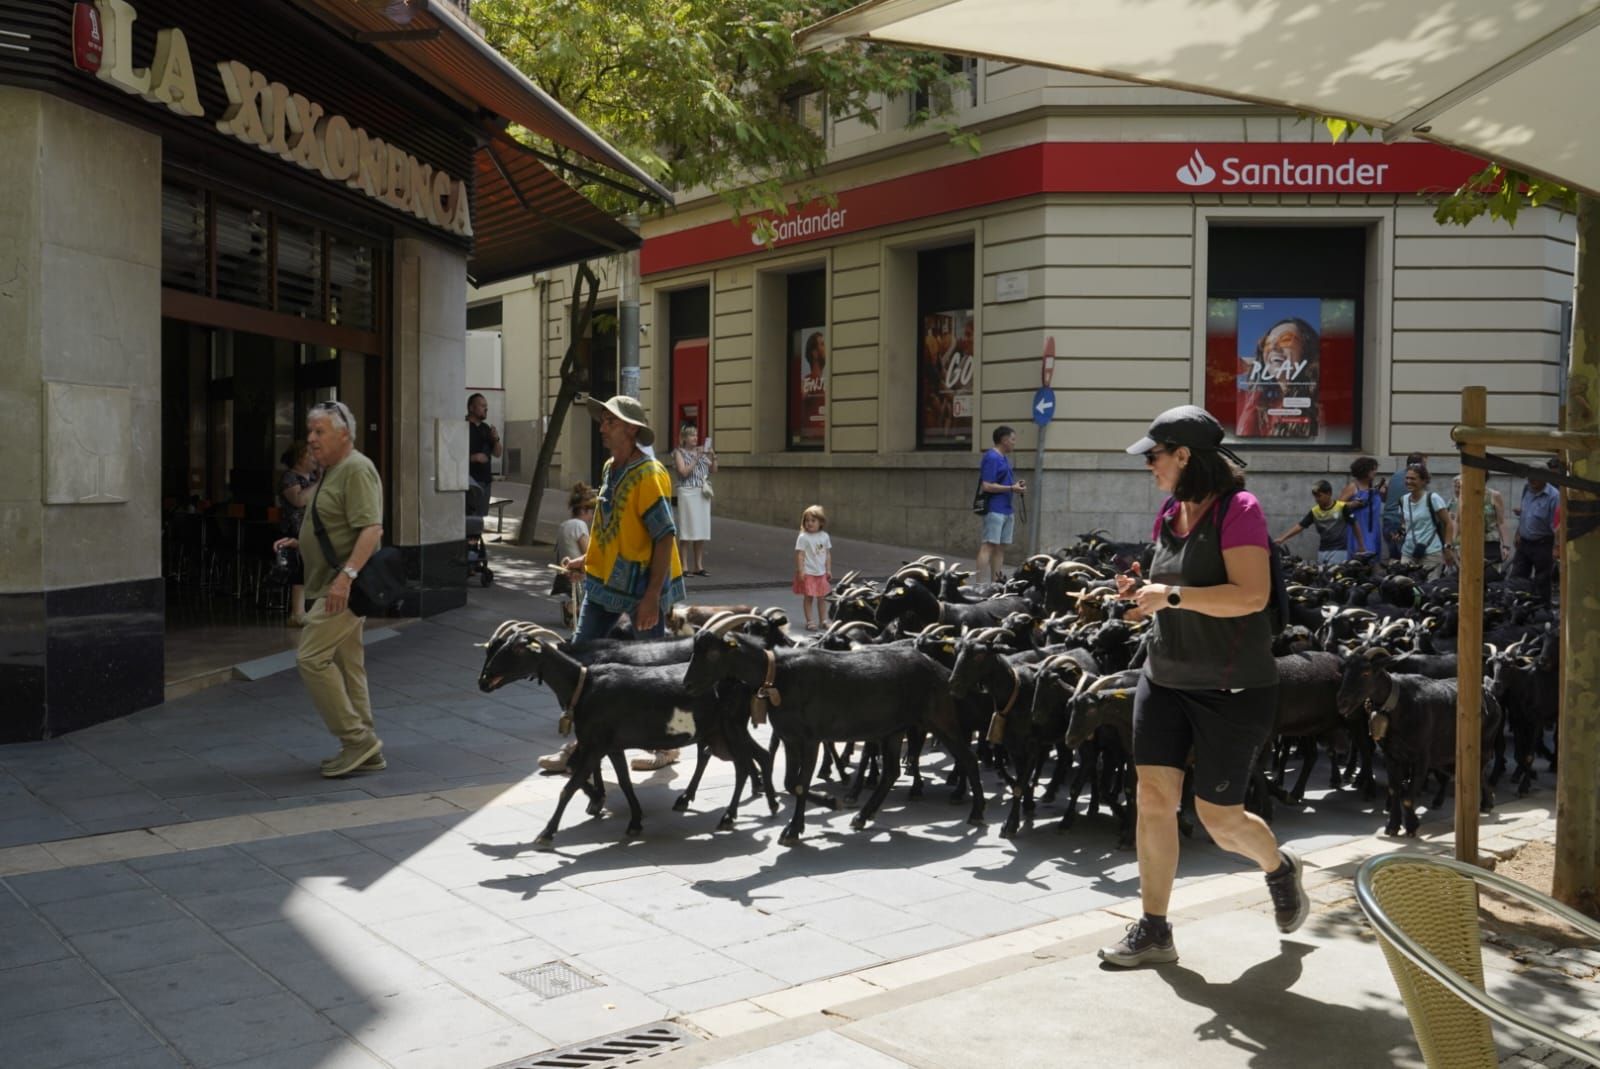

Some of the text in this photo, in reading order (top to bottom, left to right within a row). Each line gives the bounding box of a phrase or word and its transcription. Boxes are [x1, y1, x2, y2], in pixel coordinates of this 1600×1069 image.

[95, 0, 474, 237] LA XIXONENCA
[1222, 157, 1388, 186] Santander
[770, 208, 848, 242] Santander
[1249, 359, 1308, 381] PLAY
